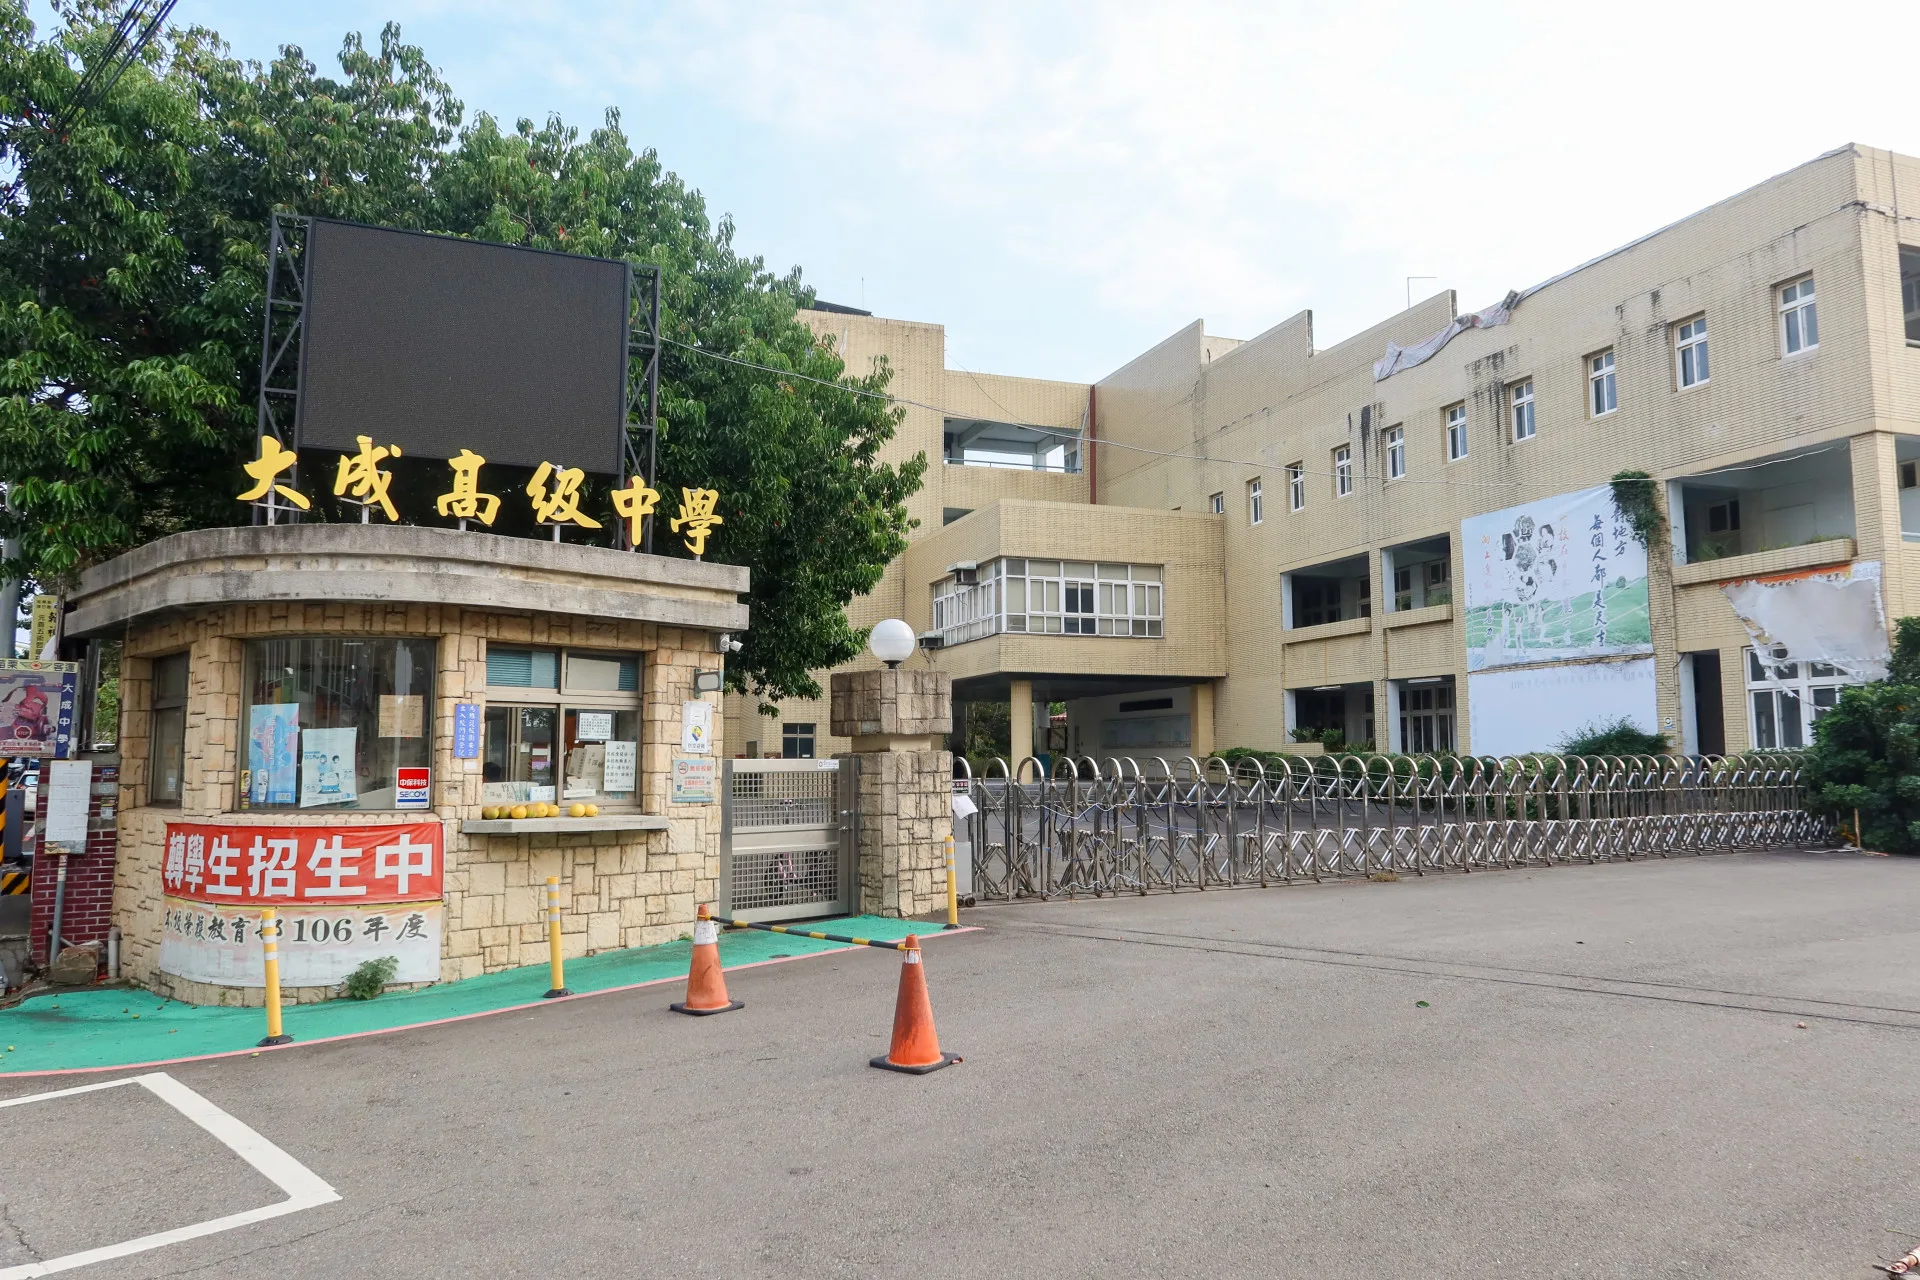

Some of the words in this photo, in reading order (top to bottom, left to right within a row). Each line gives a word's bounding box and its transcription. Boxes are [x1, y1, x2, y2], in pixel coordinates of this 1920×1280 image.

[235, 434, 723, 556] 大成高級中學
[57, 683, 74, 744] 大成中學
[399, 790, 427, 798] SECOM
[400, 779, 427, 787] 中保科技
[164, 831, 433, 898] 轉學生招生中
